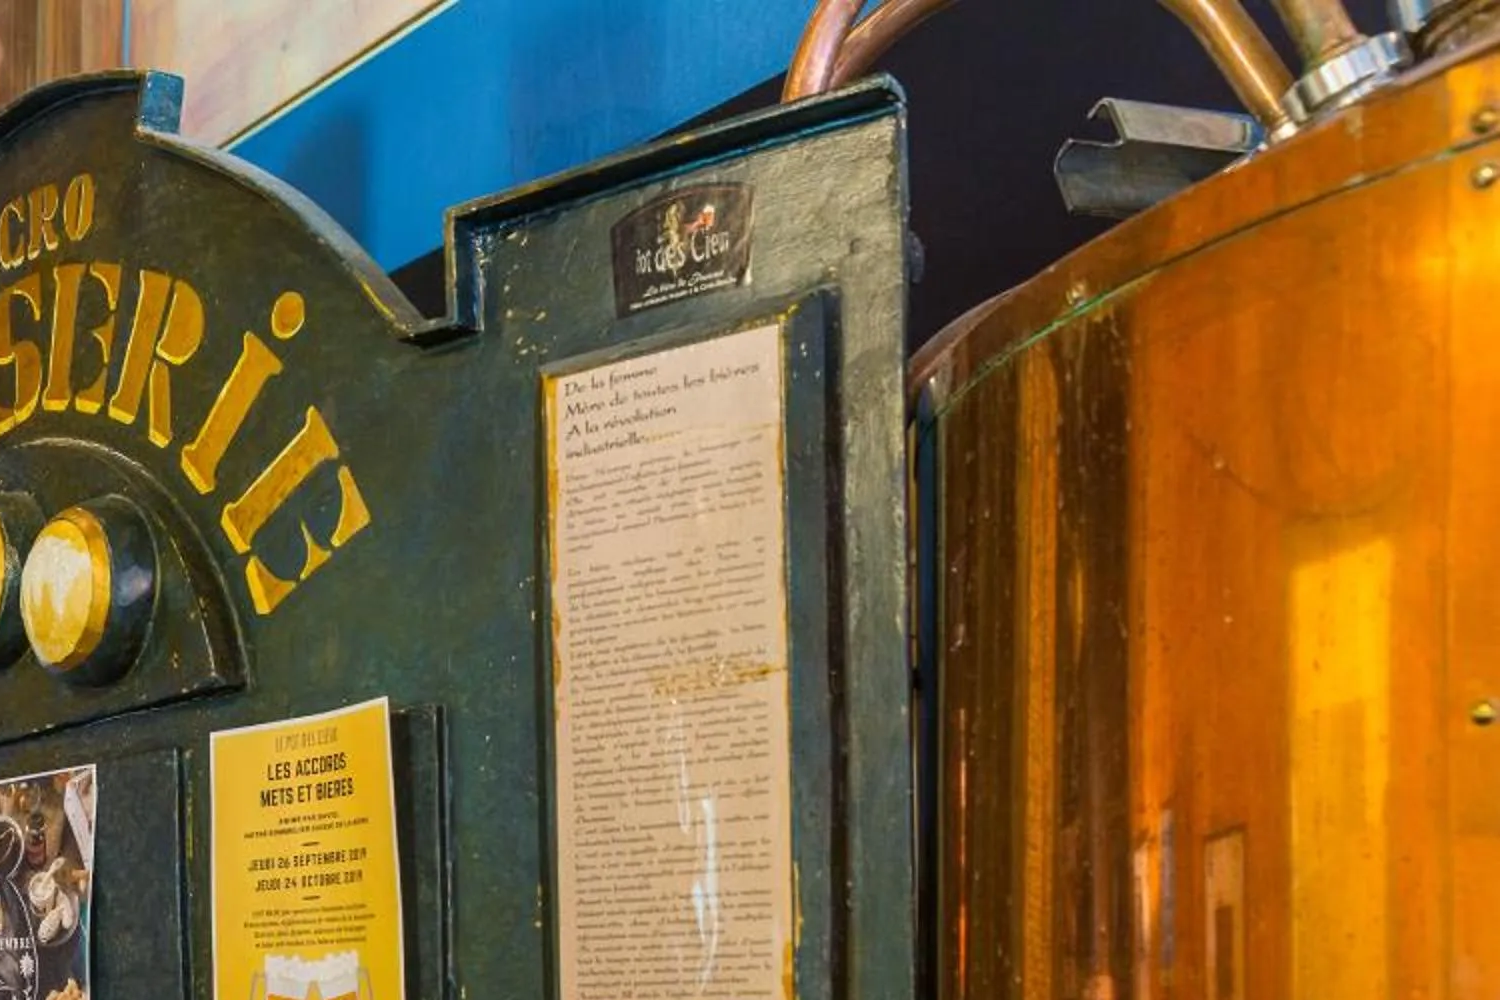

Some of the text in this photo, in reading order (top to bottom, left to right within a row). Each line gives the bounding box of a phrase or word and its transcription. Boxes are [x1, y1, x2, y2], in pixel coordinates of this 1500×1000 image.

[266, 751, 347, 781] LES ACCORDS
[260, 787, 294, 808] METS
[297, 784, 313, 803] ET
[248, 857, 275, 872] JEUDI
[293, 849, 346, 868] SEPTEMBRE
[255, 878, 281, 893] JEUDI
[301, 872, 341, 888] OCTOBRE
